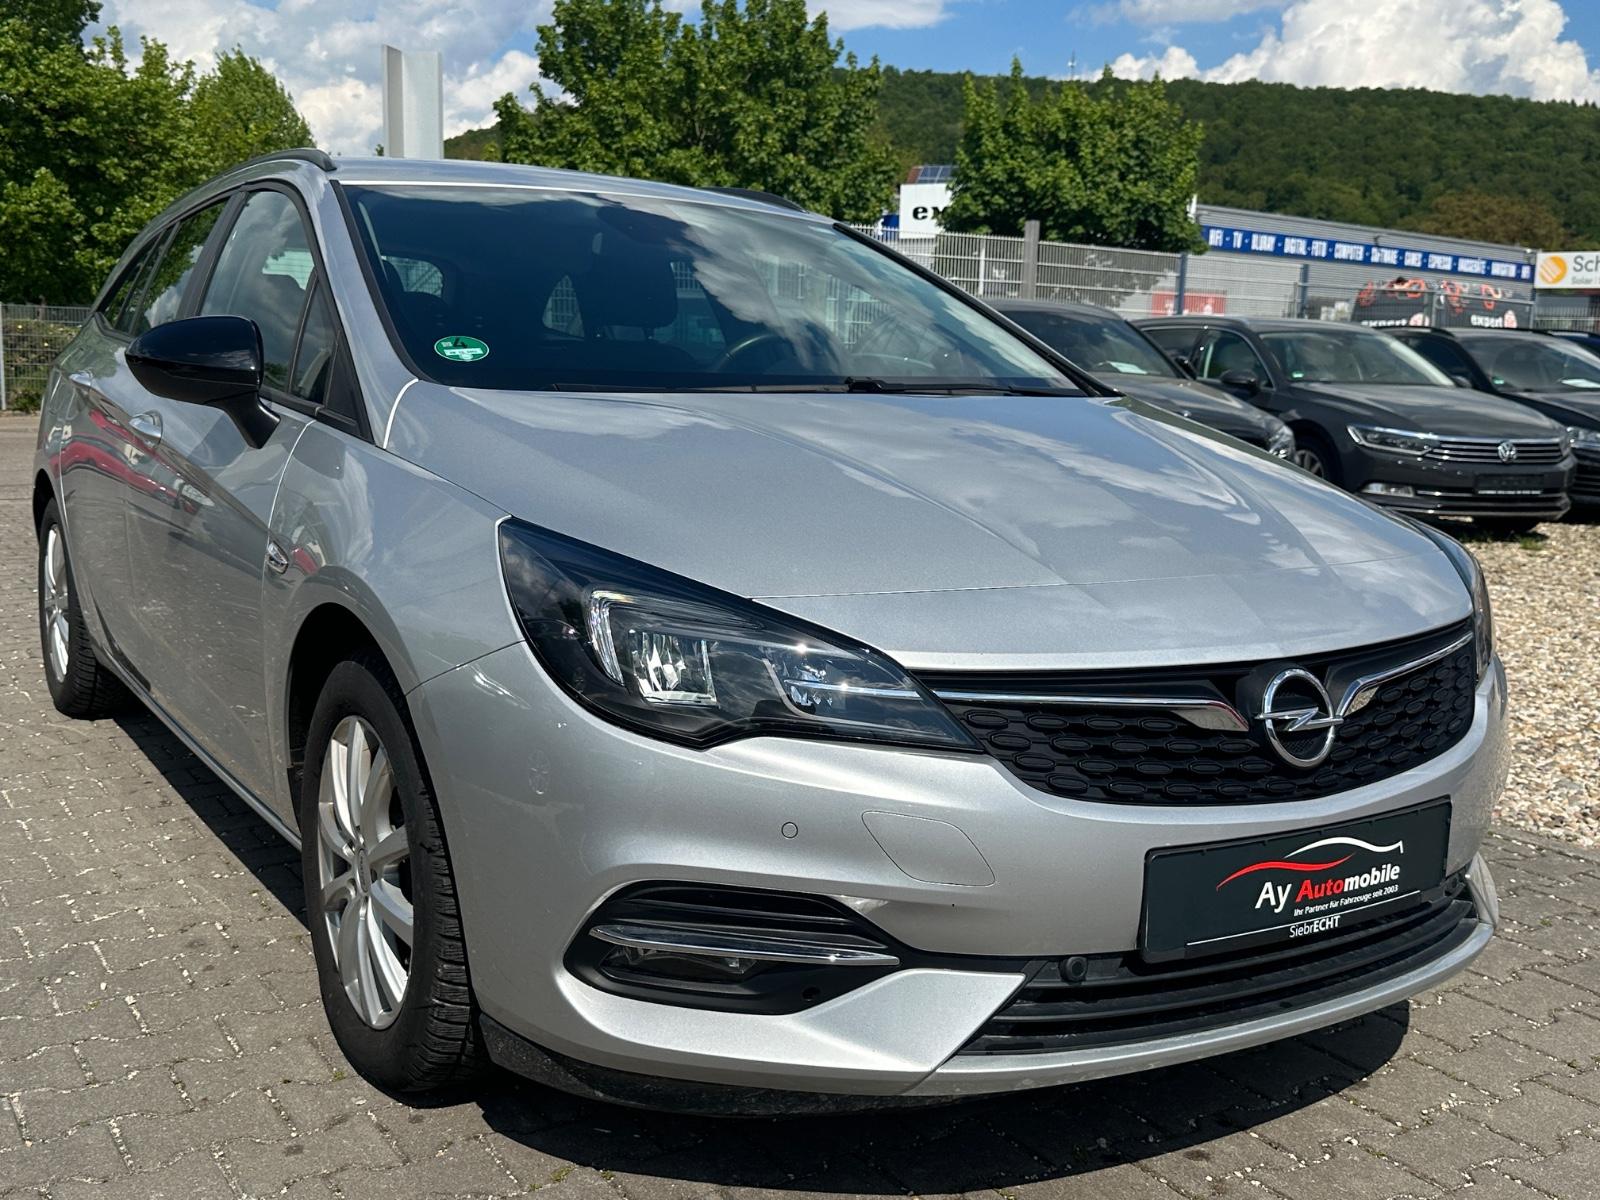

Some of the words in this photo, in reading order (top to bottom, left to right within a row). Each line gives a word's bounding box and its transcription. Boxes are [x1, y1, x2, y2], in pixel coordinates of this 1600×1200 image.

[1233, 231, 1243, 248] TV
[1334, 243, 1364, 261] COMPUTER
[453, 337, 468, 349] 4
[1255, 881, 1292, 913] Ay
[1295, 863, 1400, 902] Automobile
[1294, 908, 1304, 917] Ihr
[1304, 903, 1329, 914] Partner
[1329, 899, 1340, 909] für
[1340, 892, 1372, 906] Fahrzeuge
[1372, 889, 1383, 898] seit
[1383, 884, 1399, 895] 2003
[1289, 915, 1341, 938] SiebrECHT
